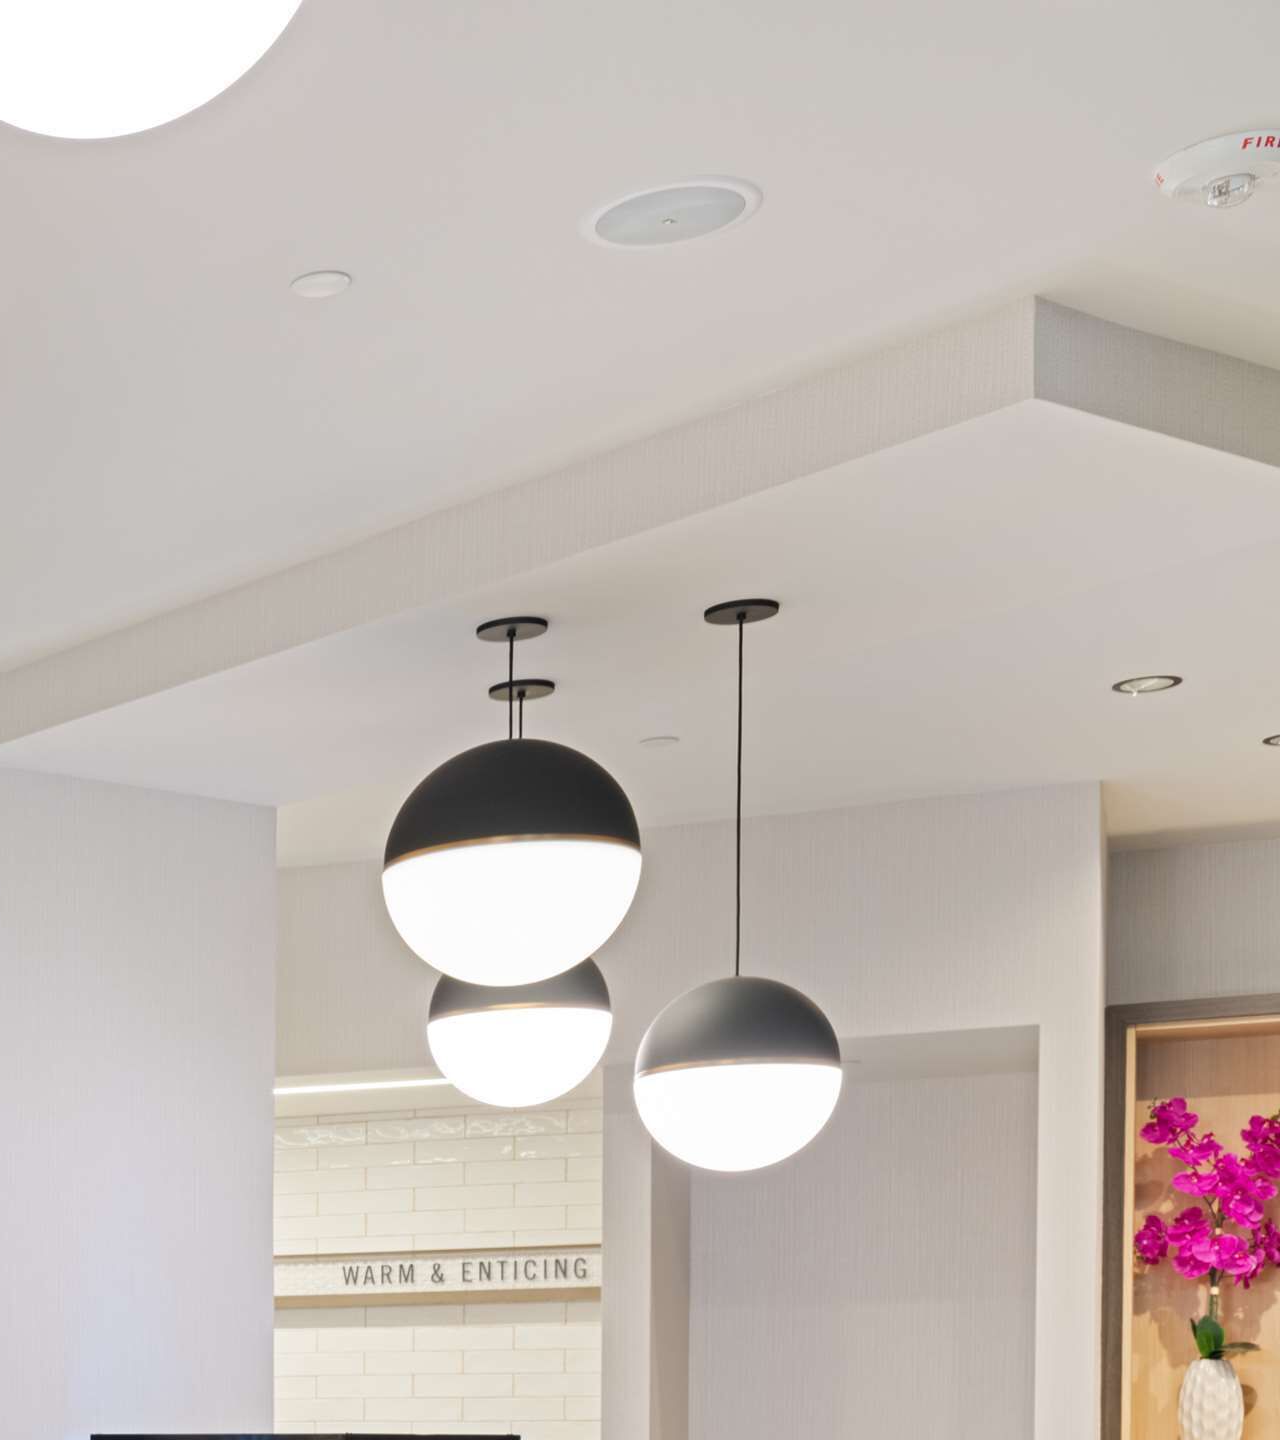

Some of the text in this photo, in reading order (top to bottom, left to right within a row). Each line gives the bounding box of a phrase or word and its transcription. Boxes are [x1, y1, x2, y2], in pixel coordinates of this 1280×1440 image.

[342, 1256, 590, 1286] WARM & ENTICING
